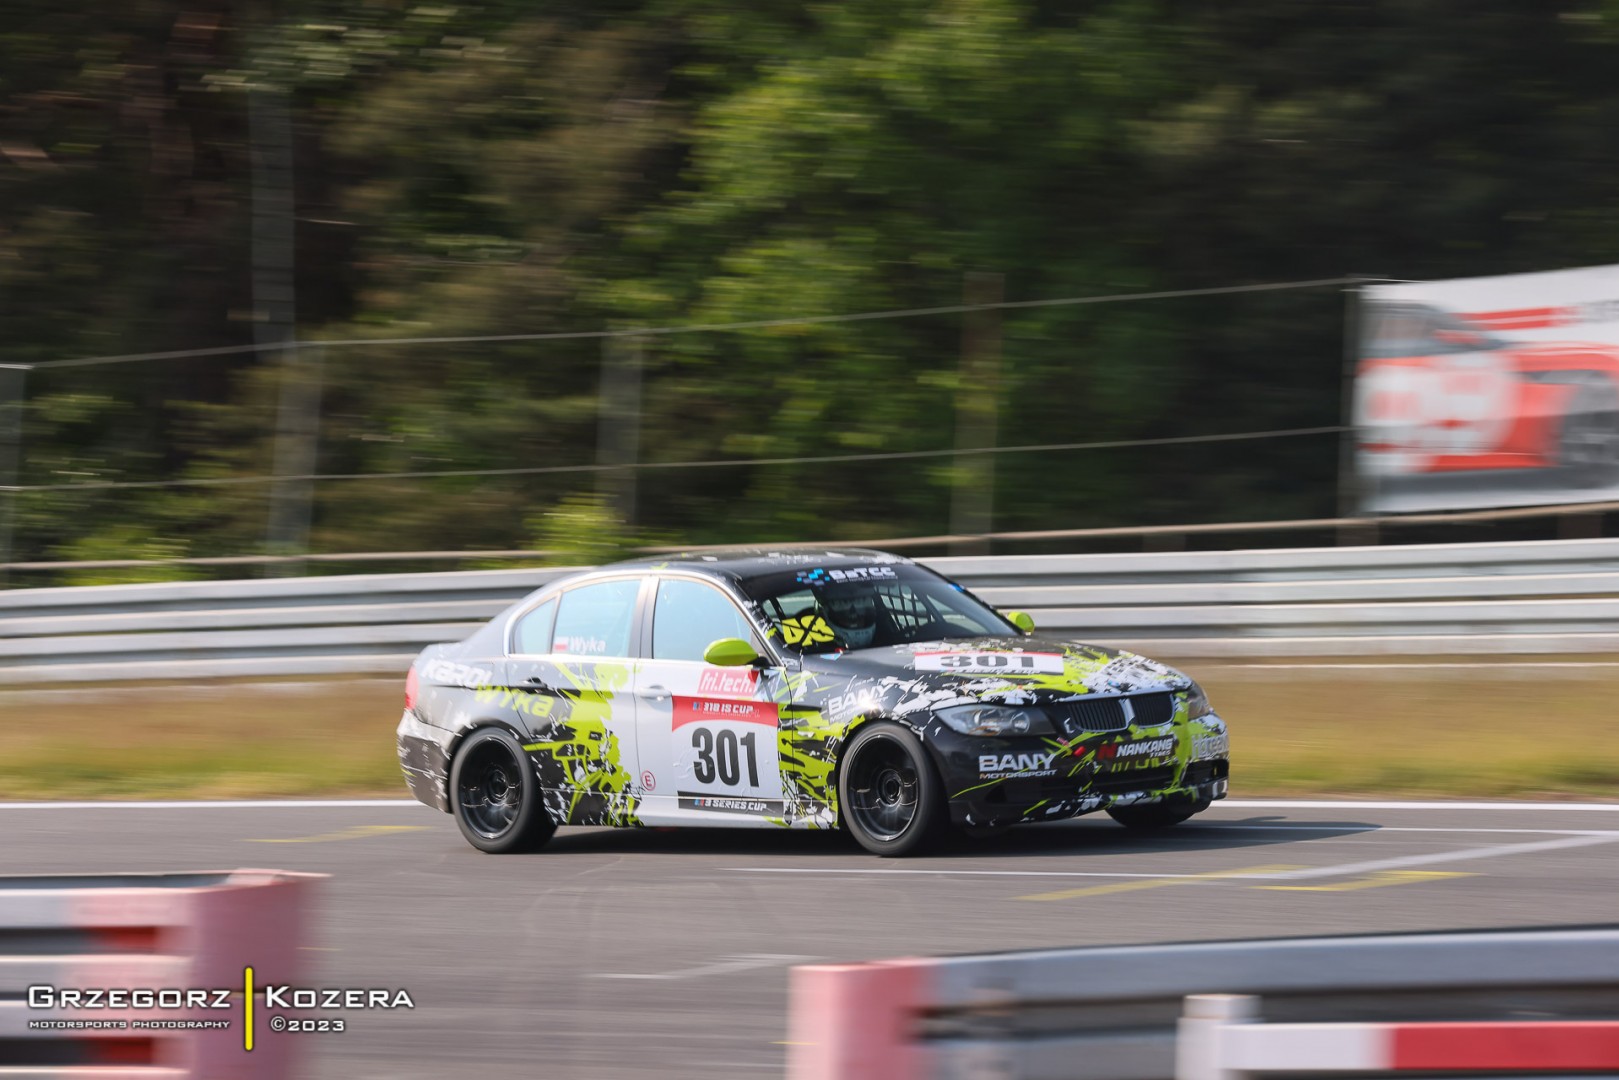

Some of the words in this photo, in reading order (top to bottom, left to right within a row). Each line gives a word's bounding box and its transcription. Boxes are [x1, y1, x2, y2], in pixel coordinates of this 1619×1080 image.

[570, 636, 606, 655] Wyka
[940, 655, 1034, 668] 301
[732, 704, 754, 714] CUP
[1116, 738, 1174, 757] NANKANG
[692, 727, 760, 788] 301
[979, 753, 1056, 772] BANY
[980, 769, 1058, 779] MOTORSPORT
[712, 799, 748, 809] SERIES
[747, 802, 767, 811] CUP
